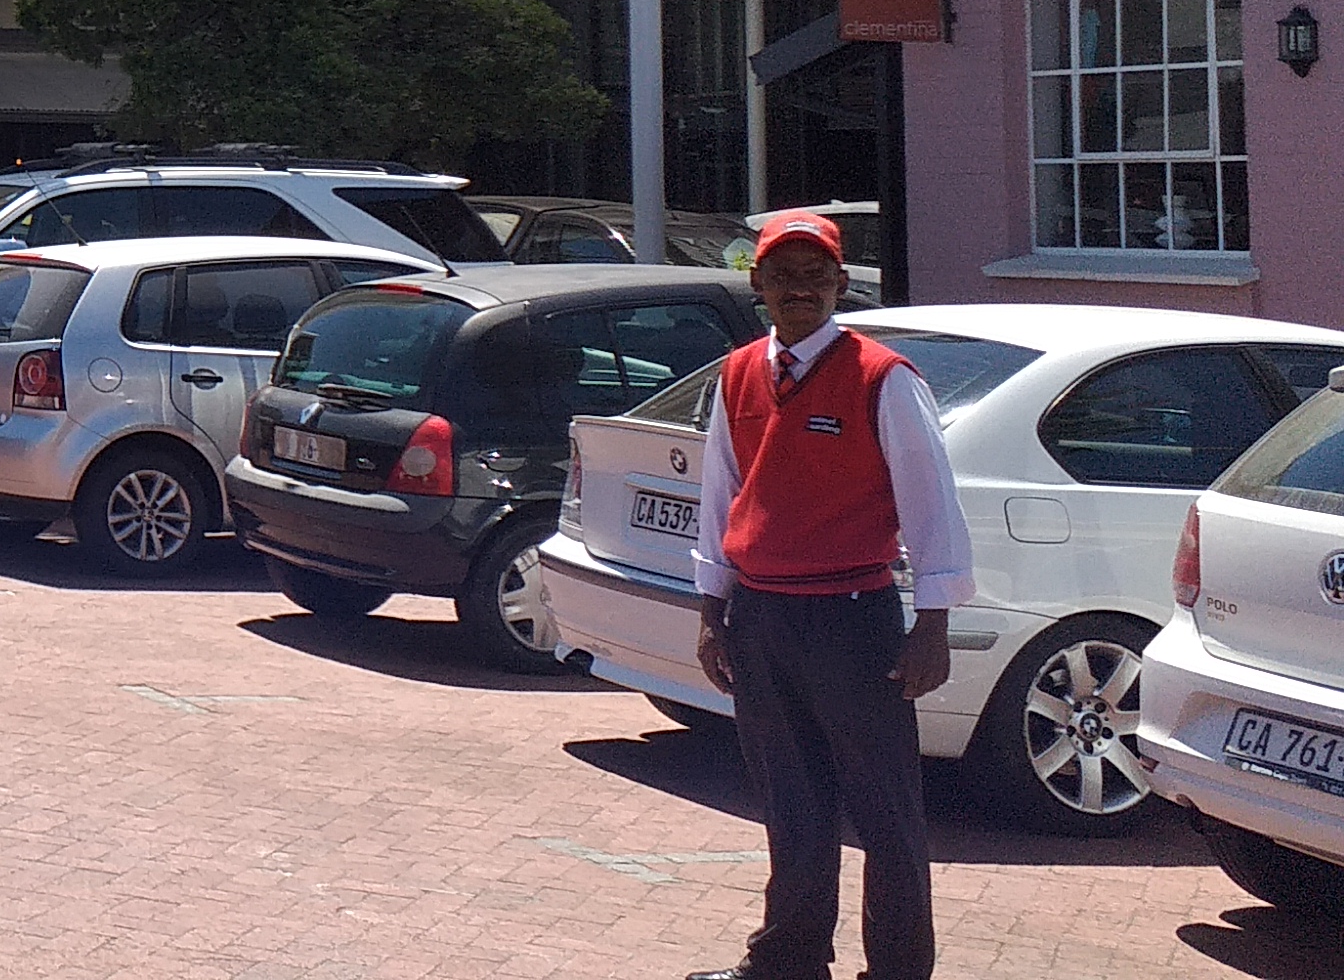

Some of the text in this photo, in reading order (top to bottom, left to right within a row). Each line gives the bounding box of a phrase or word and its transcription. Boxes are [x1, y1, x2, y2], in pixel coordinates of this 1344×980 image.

[844, 20, 938, 37] clementina
[637, 497, 699, 532] CA 539-
[1207, 597, 1238, 615] POLO
[1238, 719, 1272, 757] CA
